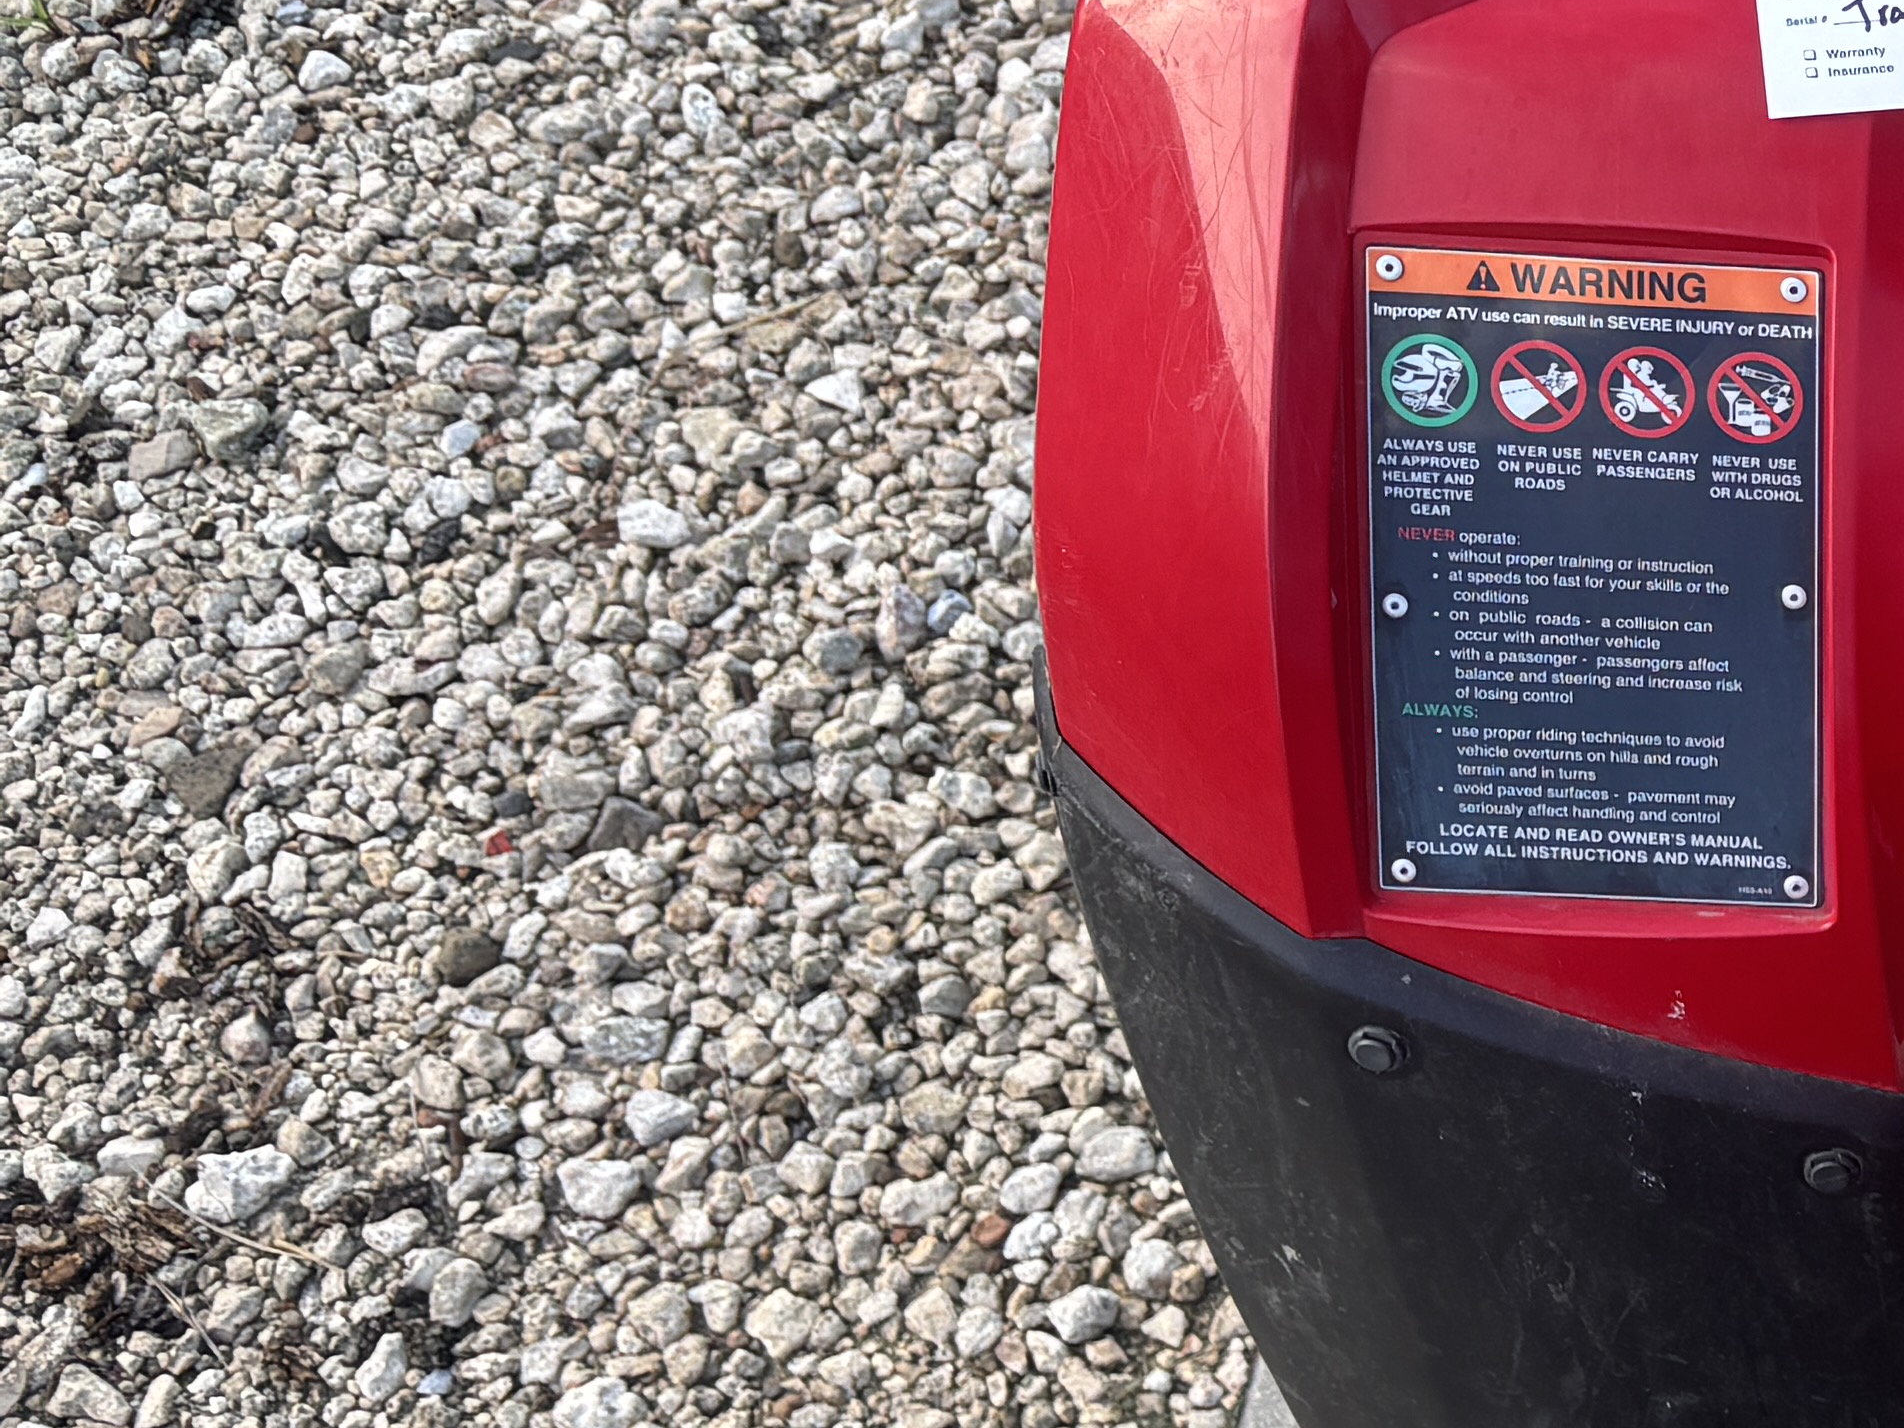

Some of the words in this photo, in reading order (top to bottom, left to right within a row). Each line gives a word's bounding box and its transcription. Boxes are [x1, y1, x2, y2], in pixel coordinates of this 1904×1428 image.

[1825, 46, 1886, 59] Warranty
[1828, 65, 1895, 77] Insurance
[1510, 264, 1707, 303] WARNING
[1373, 303, 1443, 321] Improper
[1446, 306, 1479, 321] ATV
[1481, 311, 1511, 323] use
[1512, 312, 1541, 324] can
[1543, 314, 1587, 327] result
[1589, 314, 1604, 329] in
[1607, 315, 1673, 332] SEVERE
[1675, 319, 1735, 335] INJURY
[1737, 325, 1755, 336] or
[1758, 323, 1813, 339] DEATH
[1383, 438, 1444, 452] ALWAYS
[1447, 441, 1477, 454] USE
[1497, 444, 1547, 458] NEVER
[1552, 447, 1582, 460] USE
[1377, 454, 1397, 466] AN
[1401, 455, 1480, 470] APPROVED
[1592, 448, 1643, 462] NEVER
[1647, 450, 1699, 464] CARRY
[1712, 455, 1761, 468] NEVER
[1768, 458, 1797, 471] USE
[1497, 460, 1520, 472] ON
[1525, 461, 1582, 476] PUBLIC
[1596, 464, 1696, 481] PASSENGERS
[1382, 470, 1441, 484] HELMET
[1444, 473, 1475, 485] AND
[1514, 477, 1566, 491] ROADS
[1711, 471, 1748, 483] WITH
[1751, 473, 1802, 486] DRUGS
[1384, 486, 1474, 502] PROTECTIVE
[1709, 486, 1731, 499] OR
[1734, 488, 1804, 502] ALCOHOL
[1410, 503, 1451, 516] GEAR
[1399, 527, 1455, 541] NEVER
[1459, 532, 1521, 545] operate:
[1447, 549, 1501, 564] without
[1505, 554, 1554, 568] proper
[1558, 555, 1614, 573] training
[1617, 559, 1633, 570] or
[1637, 558, 1714, 574] instruction
[1448, 569, 1463, 582] at
[1467, 571, 1522, 585] speeds
[1525, 573, 1549, 586] too
[1553, 573, 1581, 588] fast
[1584, 575, 1604, 589] for
[1608, 579, 1642, 592] your
[1646, 578, 1683, 593] skills
[1686, 582, 1702, 593] or
[1705, 581, 1729, 595] the
[1453, 590, 1529, 605] conditions
[1448, 610, 1470, 621] on
[1478, 610, 1526, 624] public
[1535, 613, 1581, 627] roads
[1601, 617, 1611, 628] a
[1615, 616, 1679, 631] collision
[1683, 621, 1713, 633] can
[1454, 630, 1499, 642] occur
[1503, 630, 1535, 644] with
[1540, 633, 1600, 647] another
[1604, 635, 1661, 650] vehicle
[1449, 647, 1481, 661] with
[1485, 650, 1495, 662] a
[1498, 651, 1578, 668] passenger
[1596, 656, 1684, 672] passengers
[1688, 658, 1729, 672] affect
[1455, 666, 1514, 682] balance
[1518, 670, 1547, 683] and
[1551, 672, 1611, 689] steering
[1615, 675, 1644, 688] and
[1648, 676, 1712, 691] increase
[1715, 679, 1743, 692] risk
[1455, 685, 1470, 699] of
[1474, 686, 1518, 704] losing
[1522, 691, 1573, 704] control
[1402, 703, 1478, 719] ALWAYS:
[1451, 726, 1479, 738] use
[1483, 728, 1532, 741] proper
[1536, 728, 1577, 745] riding
[1581, 731, 1662, 747] techniques
[1666, 734, 1681, 747] to
[1684, 736, 1725, 749] avoid
[1457, 763, 1505, 777] terrain
[1509, 766, 1537, 778] and
[1541, 765, 1555, 779] in
[1558, 767, 1596, 781] turns
[1439, 823, 1509, 839] LOCATE
[1514, 826, 1550, 841] AND
[1555, 828, 1603, 843] READ
[1607, 830, 1687, 846] OWNER'S
[1690, 834, 1763, 850] MANUAL
[1405, 840, 1479, 856] FOLLOW
[1484, 844, 1517, 858] ALL
[1521, 845, 1648, 863] INSTRUCTIONS
[1653, 851, 1689, 865] AND
[1693, 853, 1791, 869] WARNINGS.
